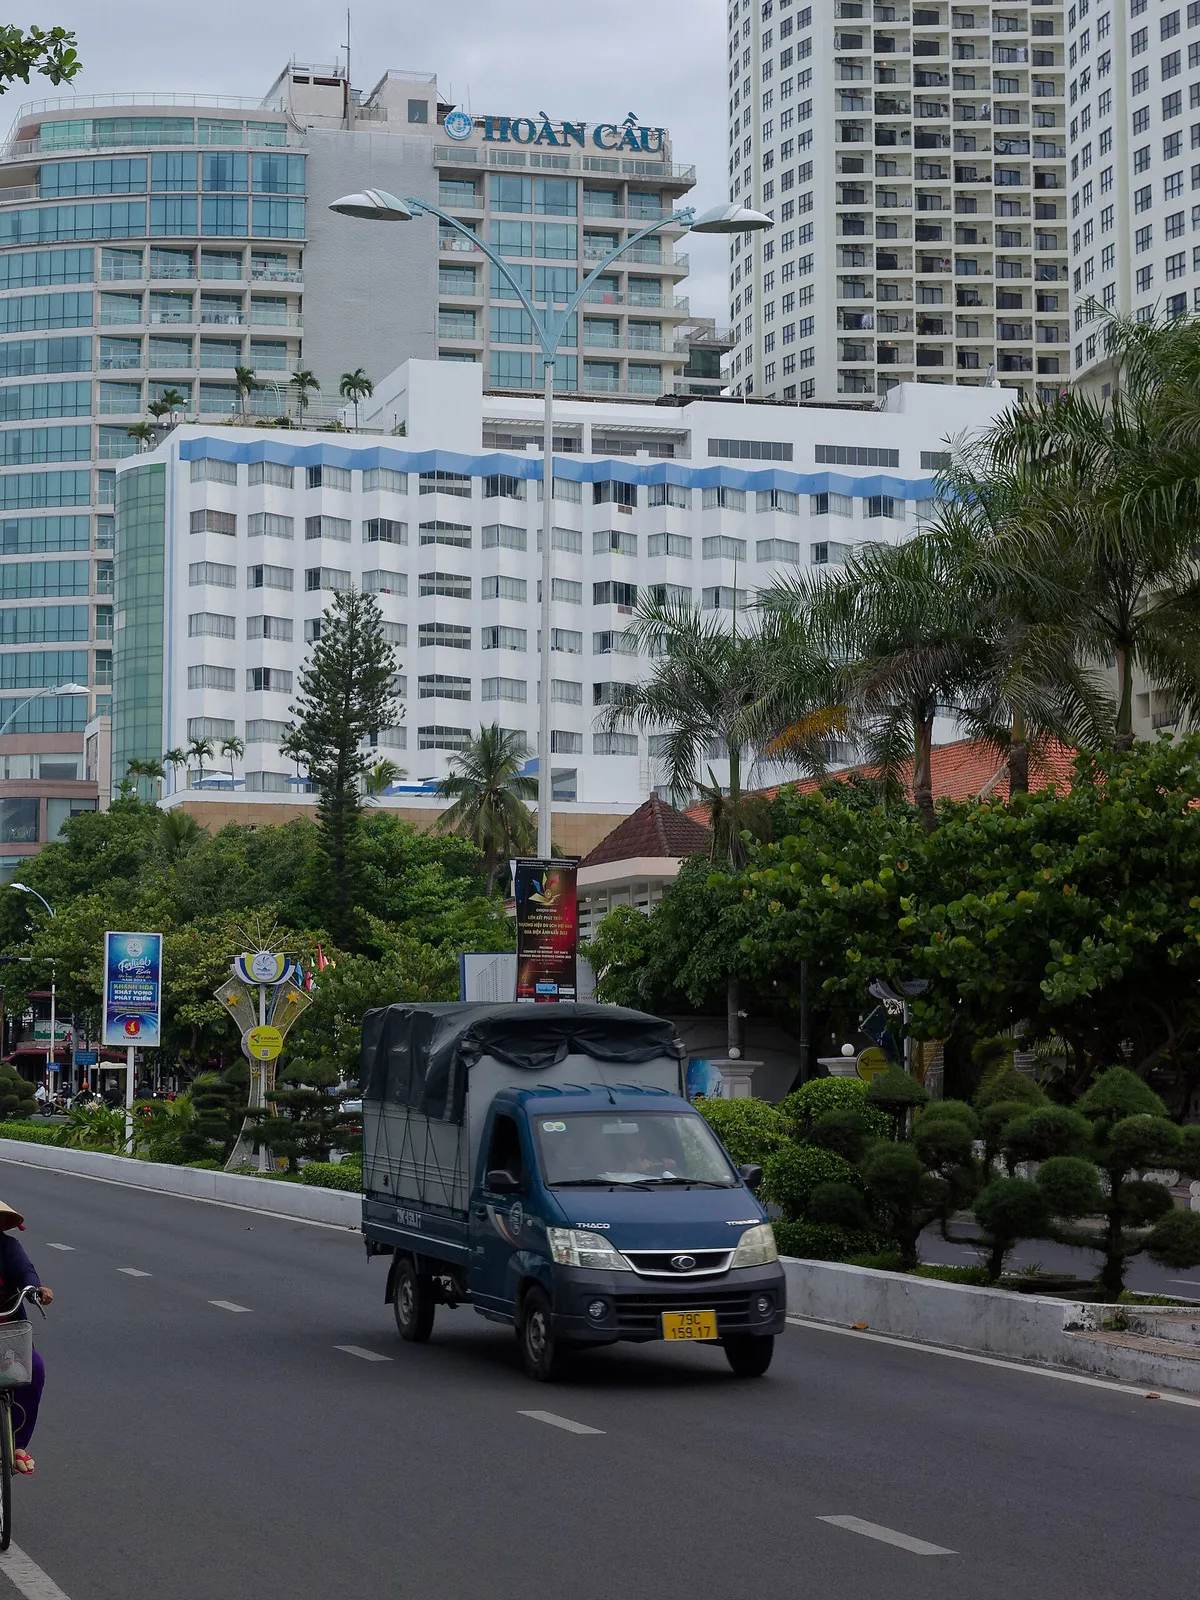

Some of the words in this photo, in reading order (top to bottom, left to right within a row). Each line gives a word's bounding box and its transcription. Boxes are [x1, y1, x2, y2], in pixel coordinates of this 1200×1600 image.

[482, 110, 586, 148] HOÀN
[592, 112, 664, 153] CẦU
[678, 1314, 701, 1326] 79C
[671, 1326, 710, 1339] 159.17
